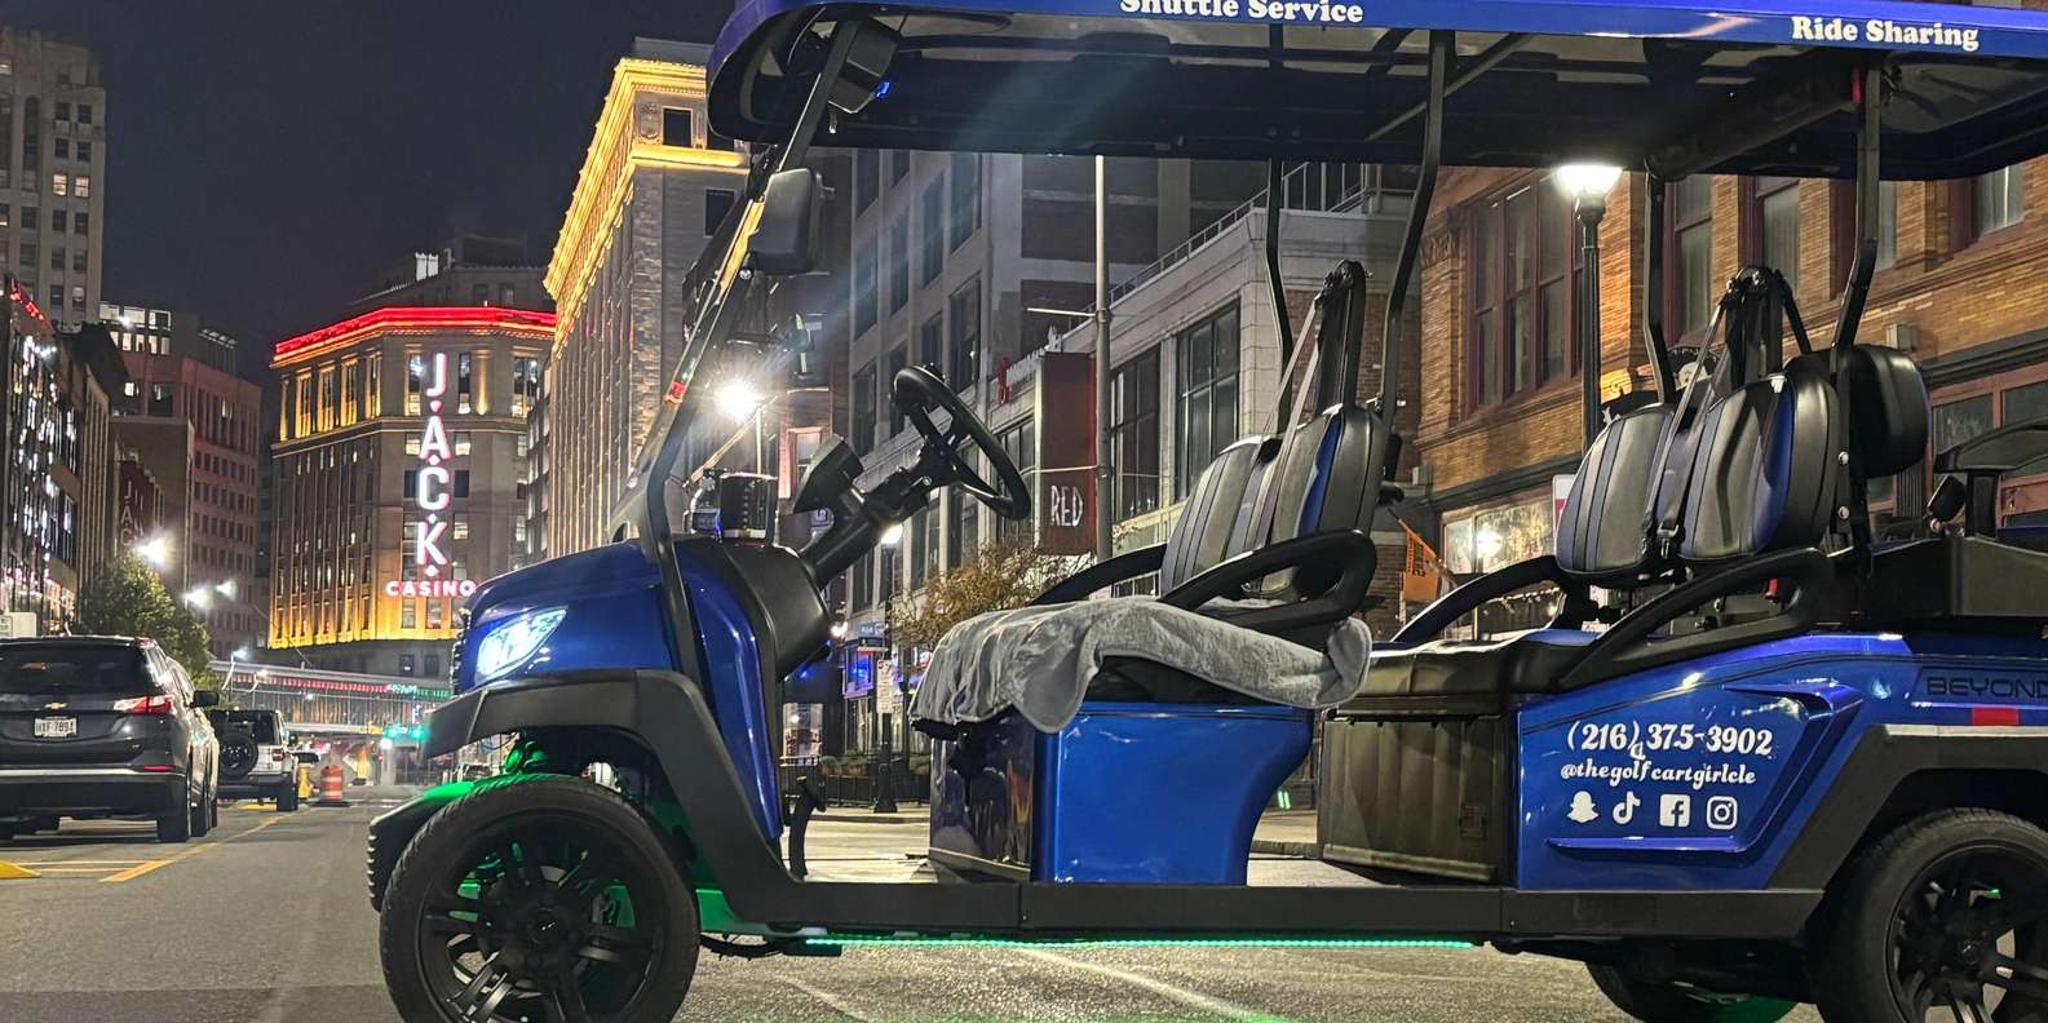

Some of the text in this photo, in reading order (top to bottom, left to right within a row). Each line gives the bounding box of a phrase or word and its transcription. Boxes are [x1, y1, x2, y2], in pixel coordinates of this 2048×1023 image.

[1120, 0, 1363, 23] Shuttle Service
[1792, 16, 1980, 52] Ride Sharing
[417, 353, 452, 566] JACK
[120, 480, 133, 546] JAC
[1051, 485, 1084, 527] RED
[386, 580, 477, 597] CASINO
[1567, 720, 1774, 756] (216) 375-3902
